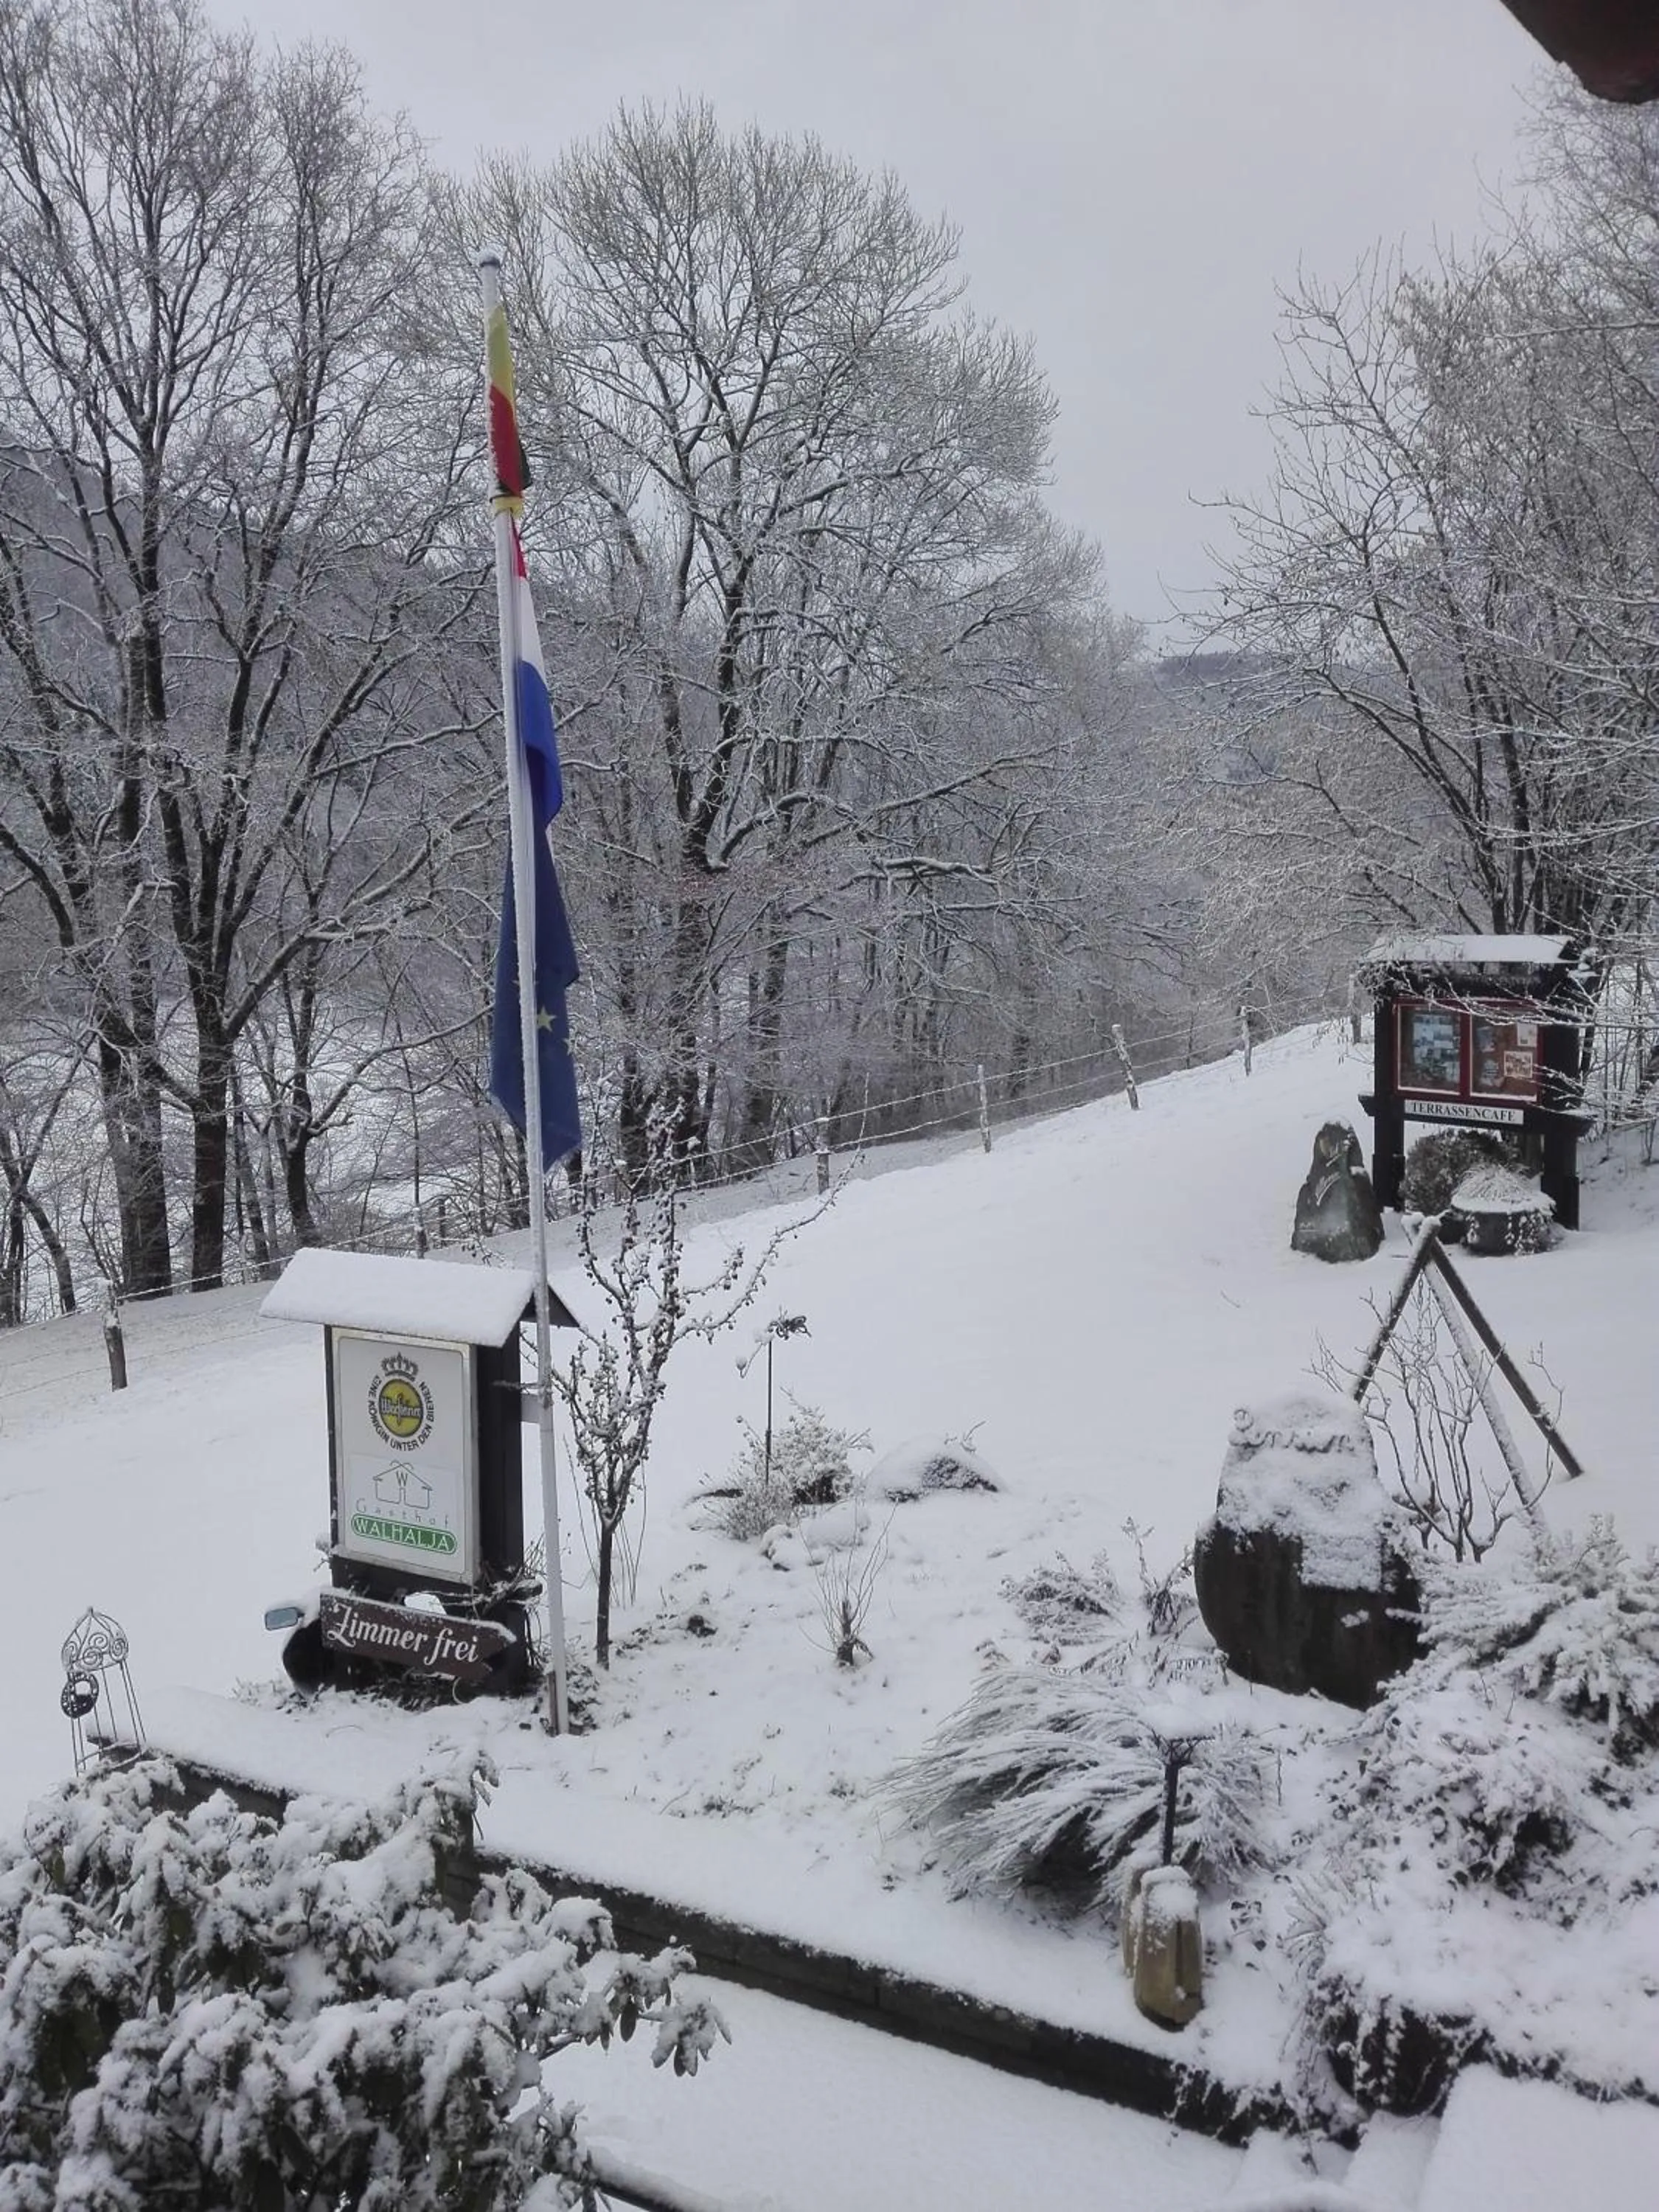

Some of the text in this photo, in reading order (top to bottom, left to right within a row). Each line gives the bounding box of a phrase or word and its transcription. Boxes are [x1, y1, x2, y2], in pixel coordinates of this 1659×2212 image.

[391, 1439, 419, 1451] UNTER
[418, 1424, 433, 1444] DEN
[356, 1519, 450, 1552] WALHALJA
[327, 1602, 479, 1666] Zimmer frei
